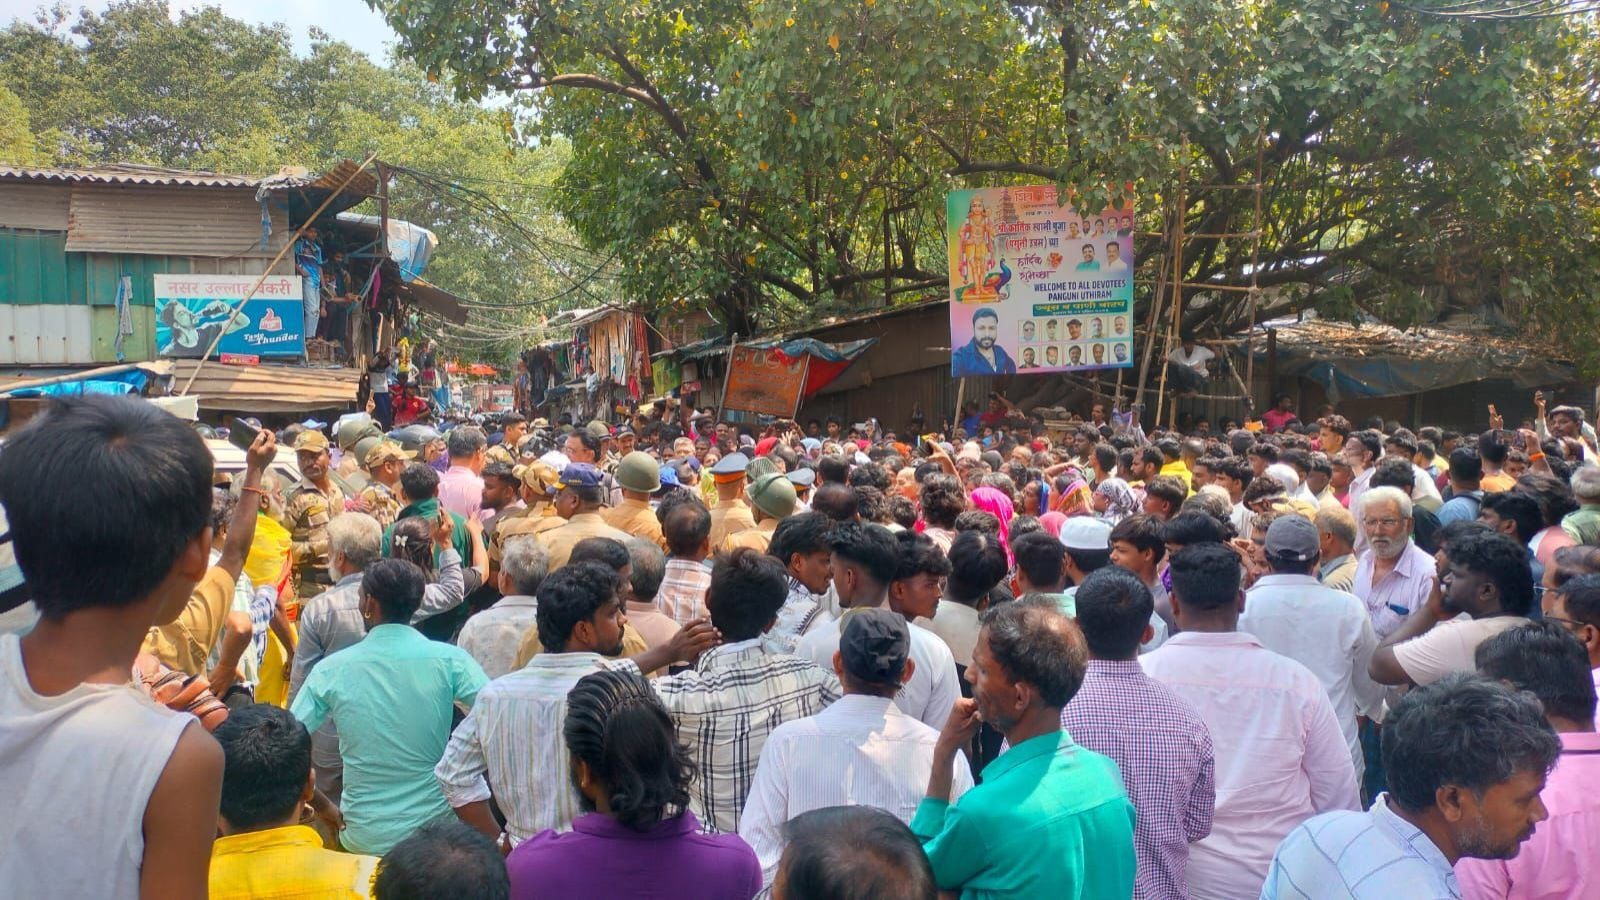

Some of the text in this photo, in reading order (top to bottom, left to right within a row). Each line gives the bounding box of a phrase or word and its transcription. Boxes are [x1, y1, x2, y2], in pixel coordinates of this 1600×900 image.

[167, 281, 199, 294] नसर
[1034, 279, 1126, 292] WELCOME TO ALL DEVOTEES
[1048, 290, 1112, 301] PANGUNI UTHIRAM
[257, 333, 299, 344] Thunder
